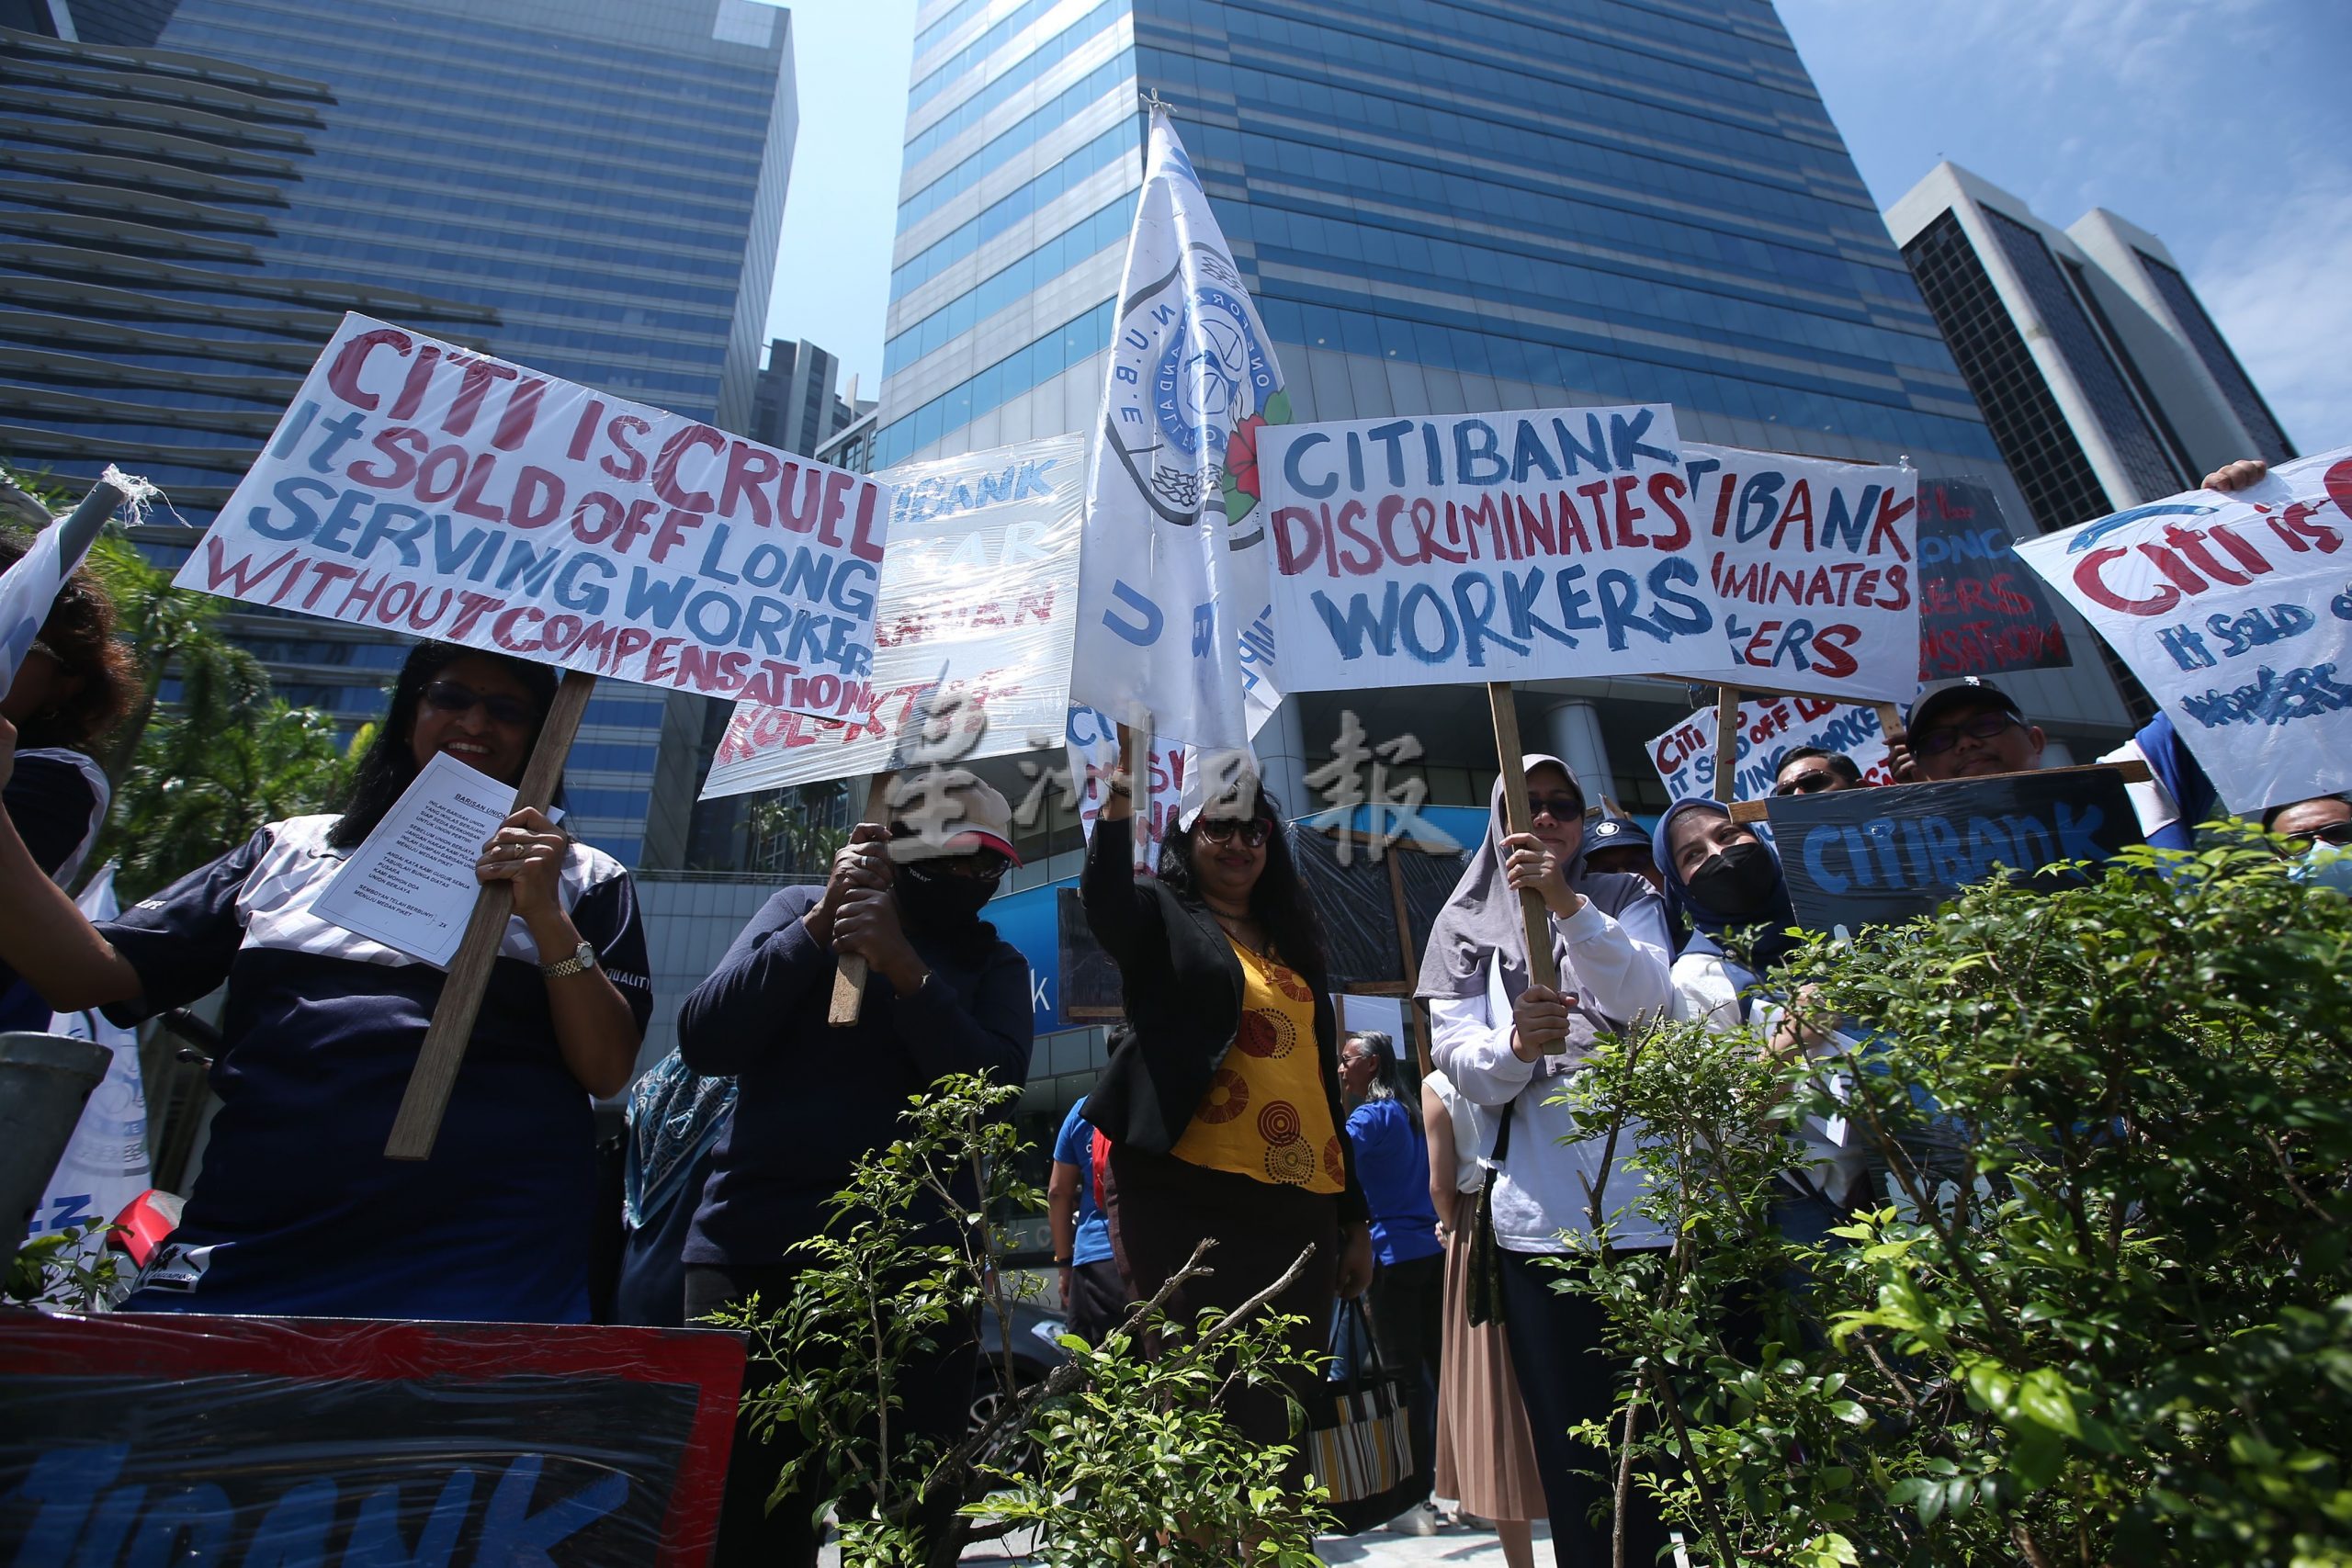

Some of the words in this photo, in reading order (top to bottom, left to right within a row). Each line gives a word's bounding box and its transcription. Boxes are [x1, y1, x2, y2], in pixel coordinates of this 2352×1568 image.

[326, 328, 546, 452] CITI
[566, 400, 652, 483] IS
[650, 423, 886, 564] CRUEL
[1283, 407, 1679, 501] CITIBANK
[346, 426, 566, 530] SOLD
[571, 491, 705, 564] OFF
[698, 523, 878, 622] LONG
[1270, 471, 1694, 579] DISCRIMINATES
[246, 476, 619, 616] SERVING
[625, 565, 875, 678] WORKER
[206, 535, 507, 642] WITHOUT
[493, 606, 873, 716] COMPENSATION
[1310, 555, 1713, 668] WORKERS
[455, 793, 487, 811] BARISAN
[415, 816, 434, 828] UNTUK
[435, 825, 451, 835] UNION
[420, 810, 434, 821] SIAP
[433, 817, 449, 828] SEDIA
[424, 805, 440, 816] YANG
[458, 821, 486, 836] BERJUANG
[446, 807, 470, 822] BARISAN
[469, 818, 486, 828] UNION
[404, 829, 427, 842] JANGAN
[427, 839, 446, 852] HARAP
[445, 847, 459, 857] KAMI
[458, 853, 477, 863] PULAN
[409, 823, 435, 839] SEBELUM
[435, 835, 452, 846] UNION
[451, 842, 475, 855] BERJAYA
[378, 862, 401, 875] PUSARA
[386, 851, 405, 863] ANDAI
[404, 858, 419, 868] KATA
[418, 864, 434, 875] KAMI
[433, 871, 453, 882] GUGUR
[395, 840, 419, 853] MENUJU
[417, 850, 438, 862] MEDAN
[436, 858, 454, 868] PIKET
[419, 842, 441, 855] SUMPAH
[440, 852, 464, 866] BARISAN
[368, 873, 387, 885] UNION
[385, 881, 411, 895] BERJAYA
[372, 867, 388, 877] KAMI
[387, 874, 408, 886] MOHON
[407, 882, 420, 891] DOA
[411, 869, 430, 881] BUNGA
[429, 876, 450, 888] DIATAS
[353, 889, 378, 903] MENUJU
[376, 899, 397, 911] MEDAN
[395, 908, 413, 918] PIKET
[358, 884, 389, 900] SEMBOYAN
[389, 897, 407, 908] TELAH
